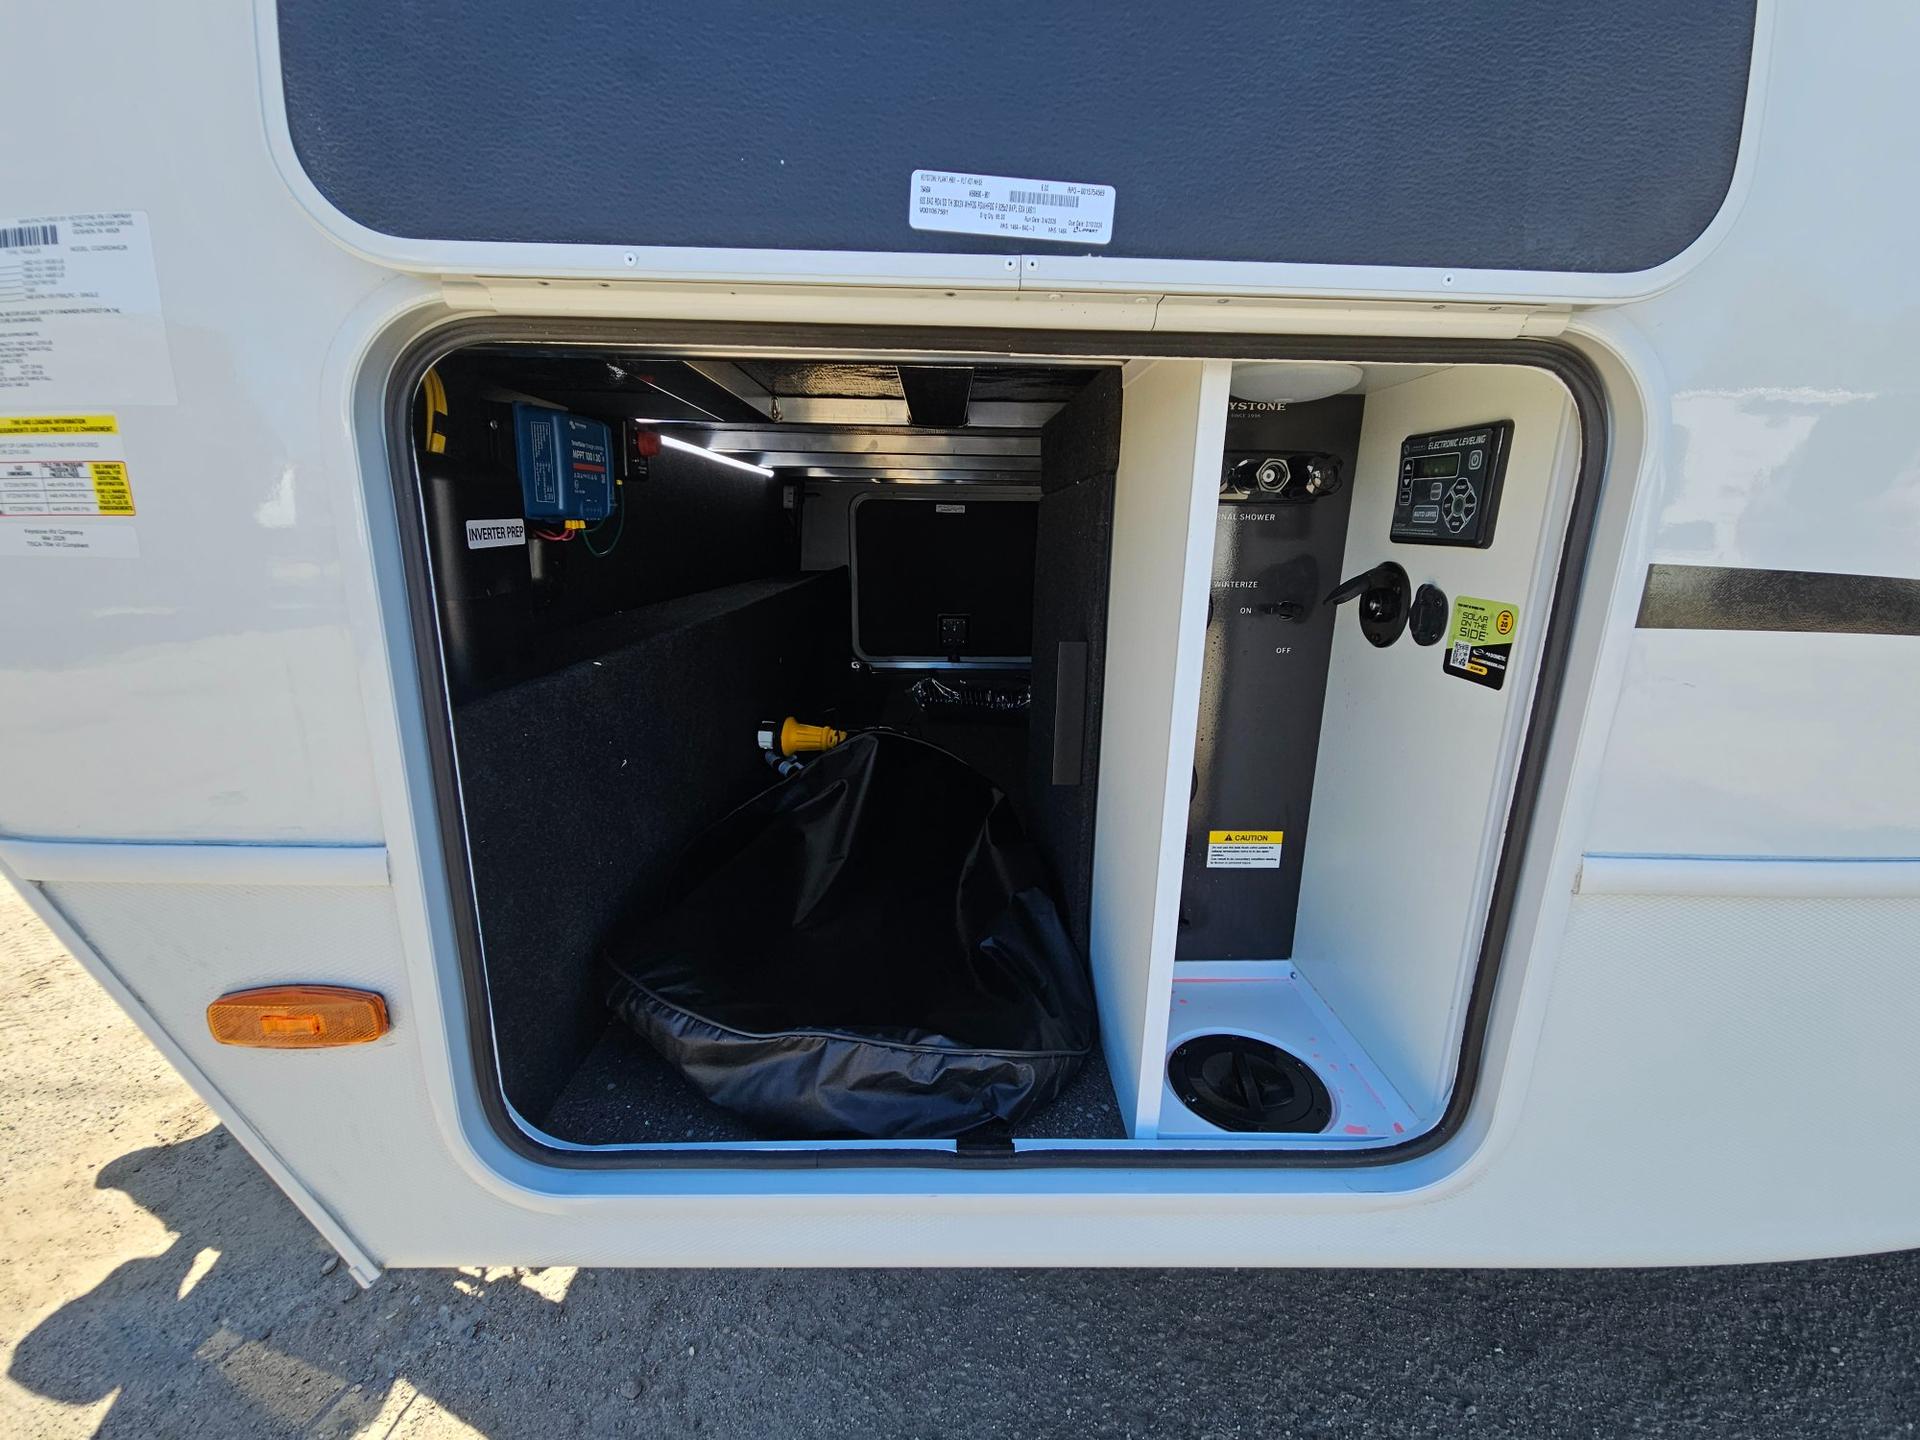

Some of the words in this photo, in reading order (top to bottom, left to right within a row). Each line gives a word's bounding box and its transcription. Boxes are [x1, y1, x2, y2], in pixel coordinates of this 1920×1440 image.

[1230, 402, 1286, 410] YSTONE
[1428, 438, 1458, 450] ELECTRONIC
[1458, 434, 1486, 446] LEVELING
[469, 526, 506, 541] INVERTER
[506, 526, 524, 538] PREP
[1462, 612, 1488, 624] SOLAR
[1472, 622, 1488, 631] THE
